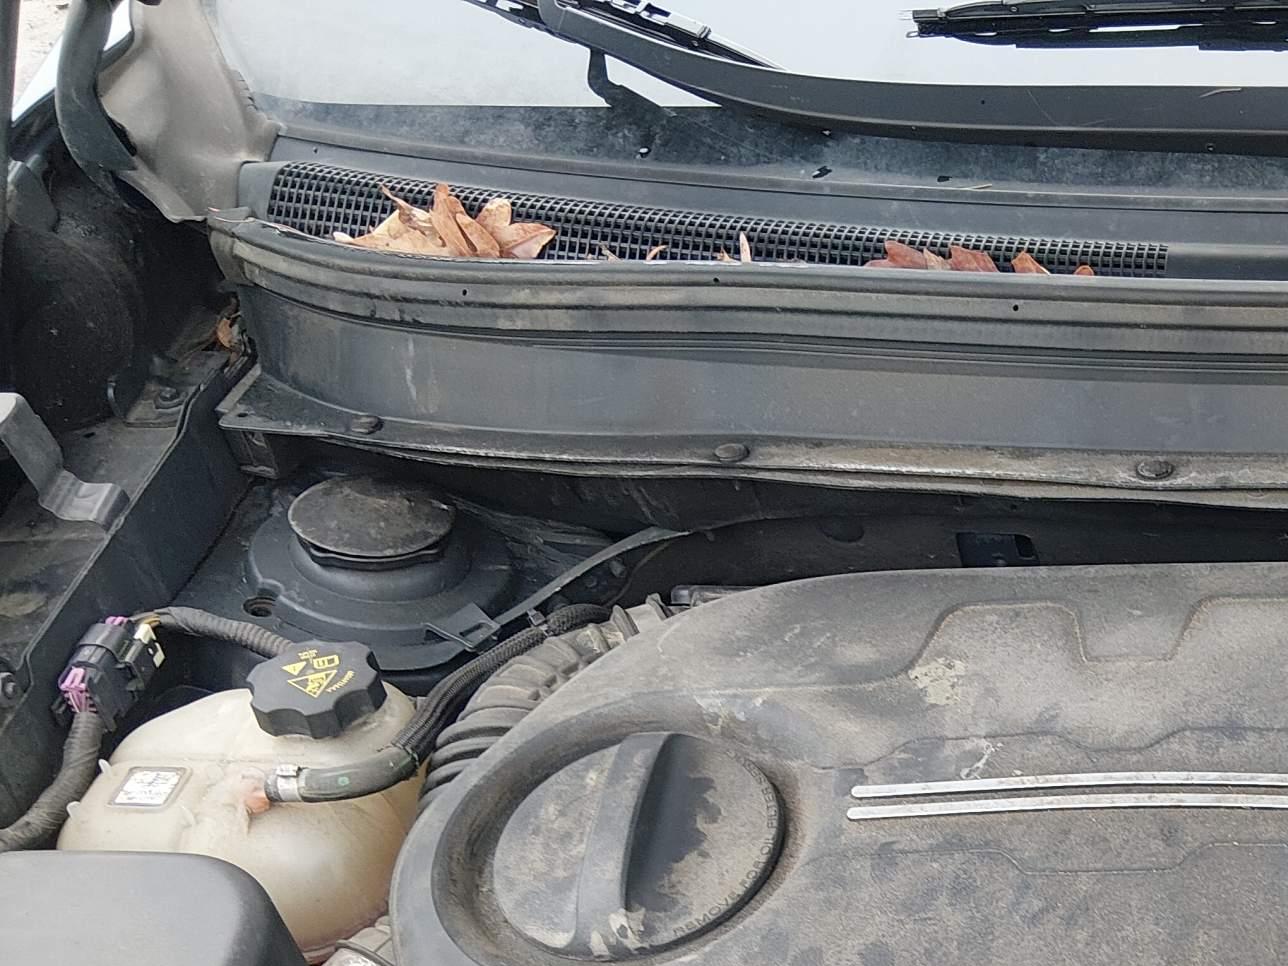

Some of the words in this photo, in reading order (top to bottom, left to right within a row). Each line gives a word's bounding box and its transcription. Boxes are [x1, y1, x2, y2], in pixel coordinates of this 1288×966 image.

[760, 786, 779, 829] FILTER
[759, 835, 776, 856] OIL
[739, 859, 767, 889] FOR
[672, 890, 741, 936] REMOVE
